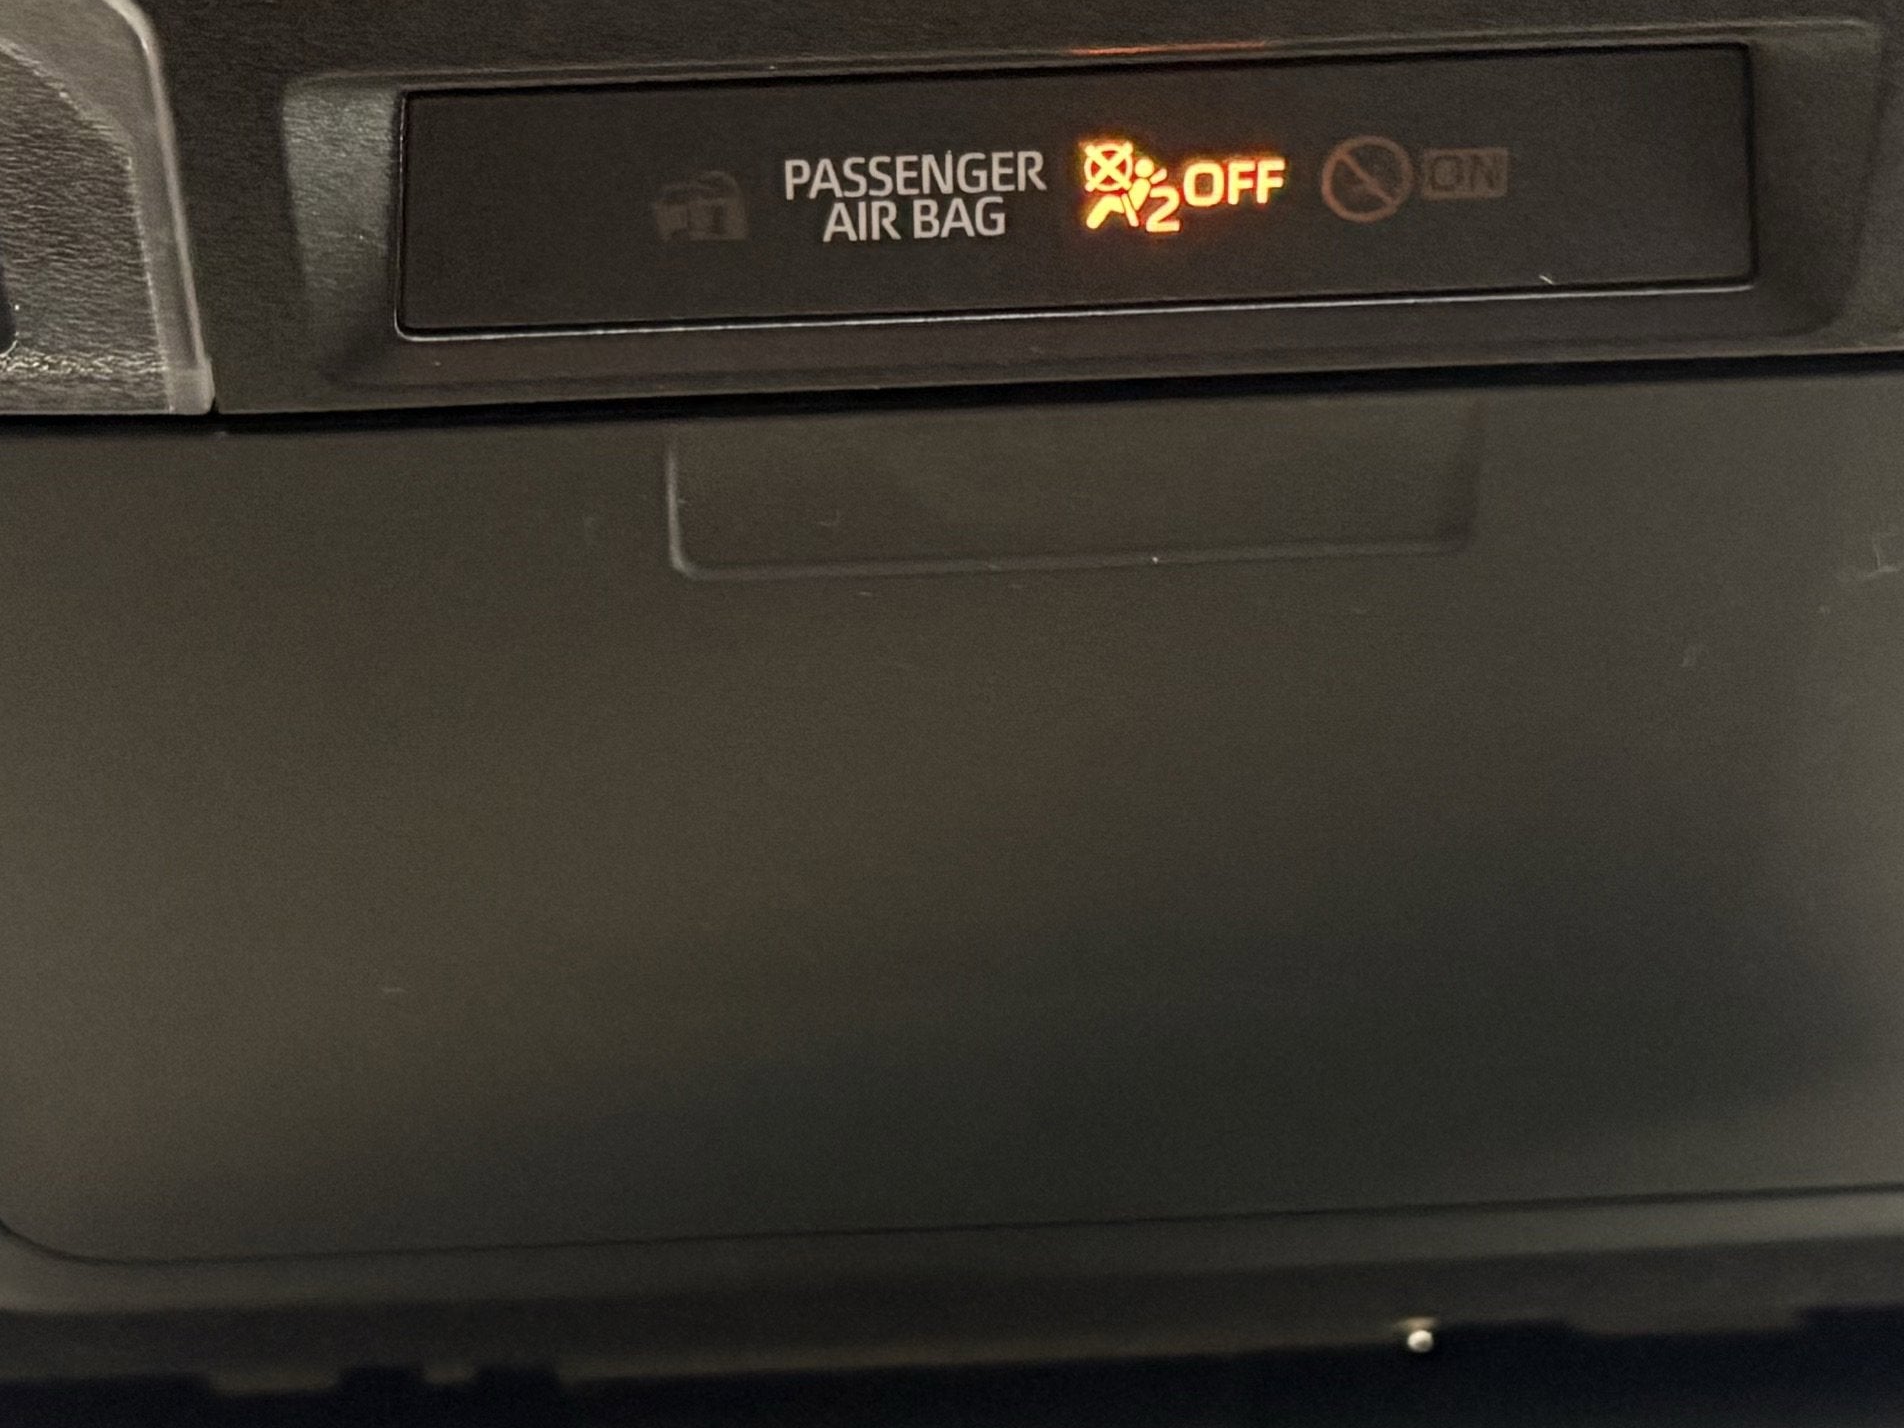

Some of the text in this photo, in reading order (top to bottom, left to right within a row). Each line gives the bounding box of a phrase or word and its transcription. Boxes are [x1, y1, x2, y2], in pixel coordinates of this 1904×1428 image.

[784, 150, 1047, 202] PASSENGER
[1183, 158, 1287, 208] OFF
[1429, 153, 1501, 191] ON
[822, 195, 1007, 243] AIR BAG
